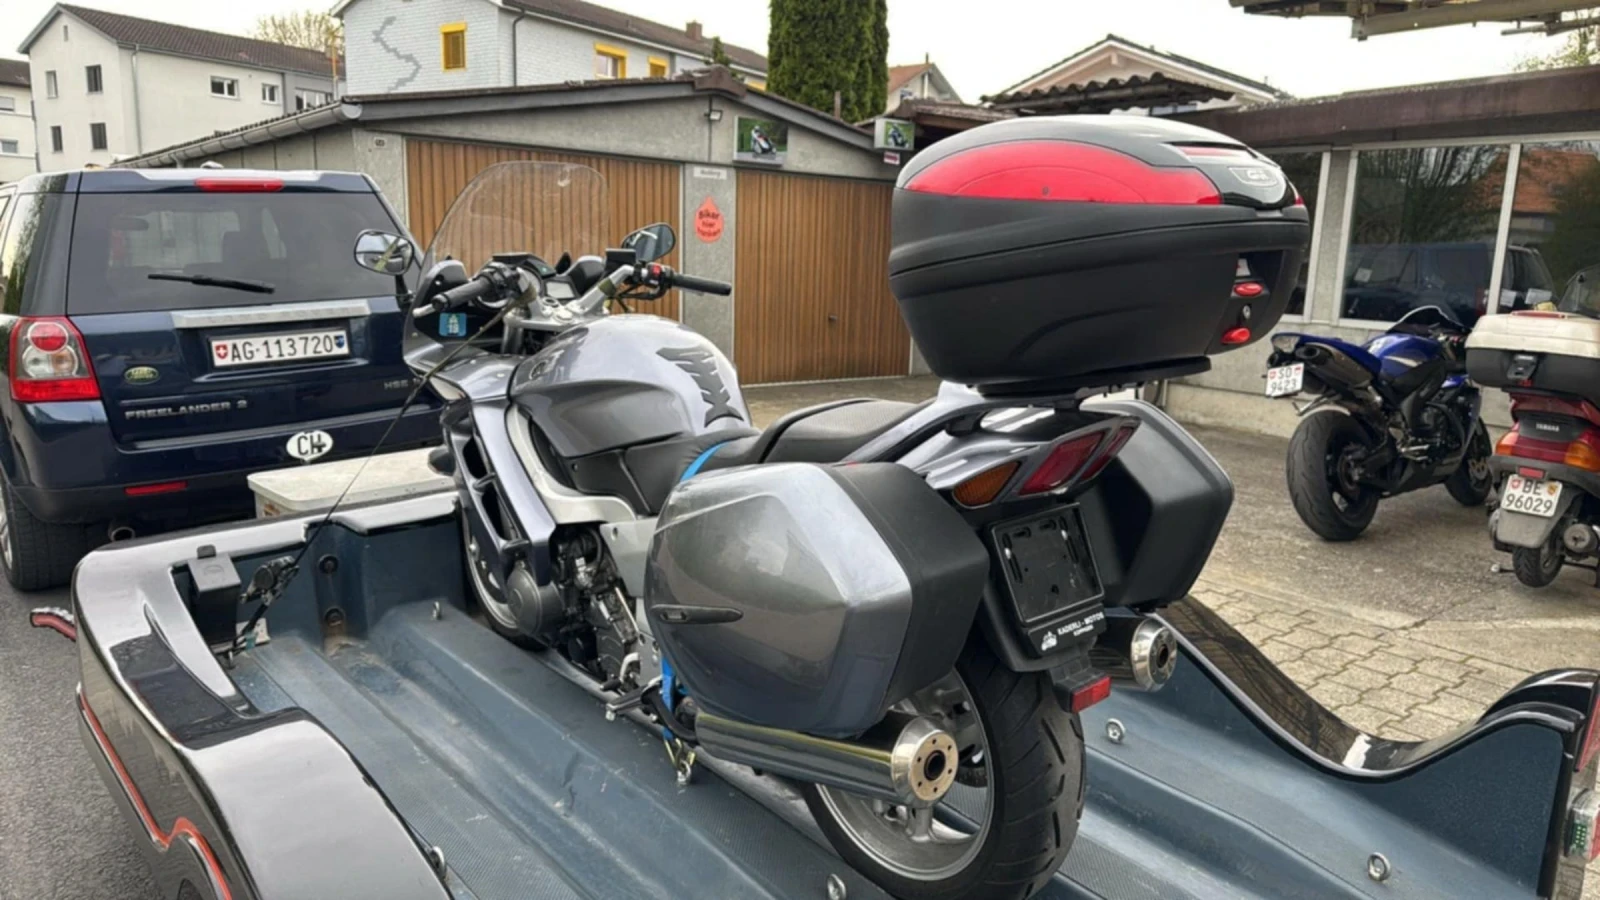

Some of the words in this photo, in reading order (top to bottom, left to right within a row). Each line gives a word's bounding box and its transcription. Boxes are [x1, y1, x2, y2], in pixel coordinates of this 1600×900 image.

[125, 401, 231, 419] FREELANDER
[237, 399, 248, 409] 2
[1522, 479, 1543, 496] BE
[1506, 493, 1553, 514] 96029
